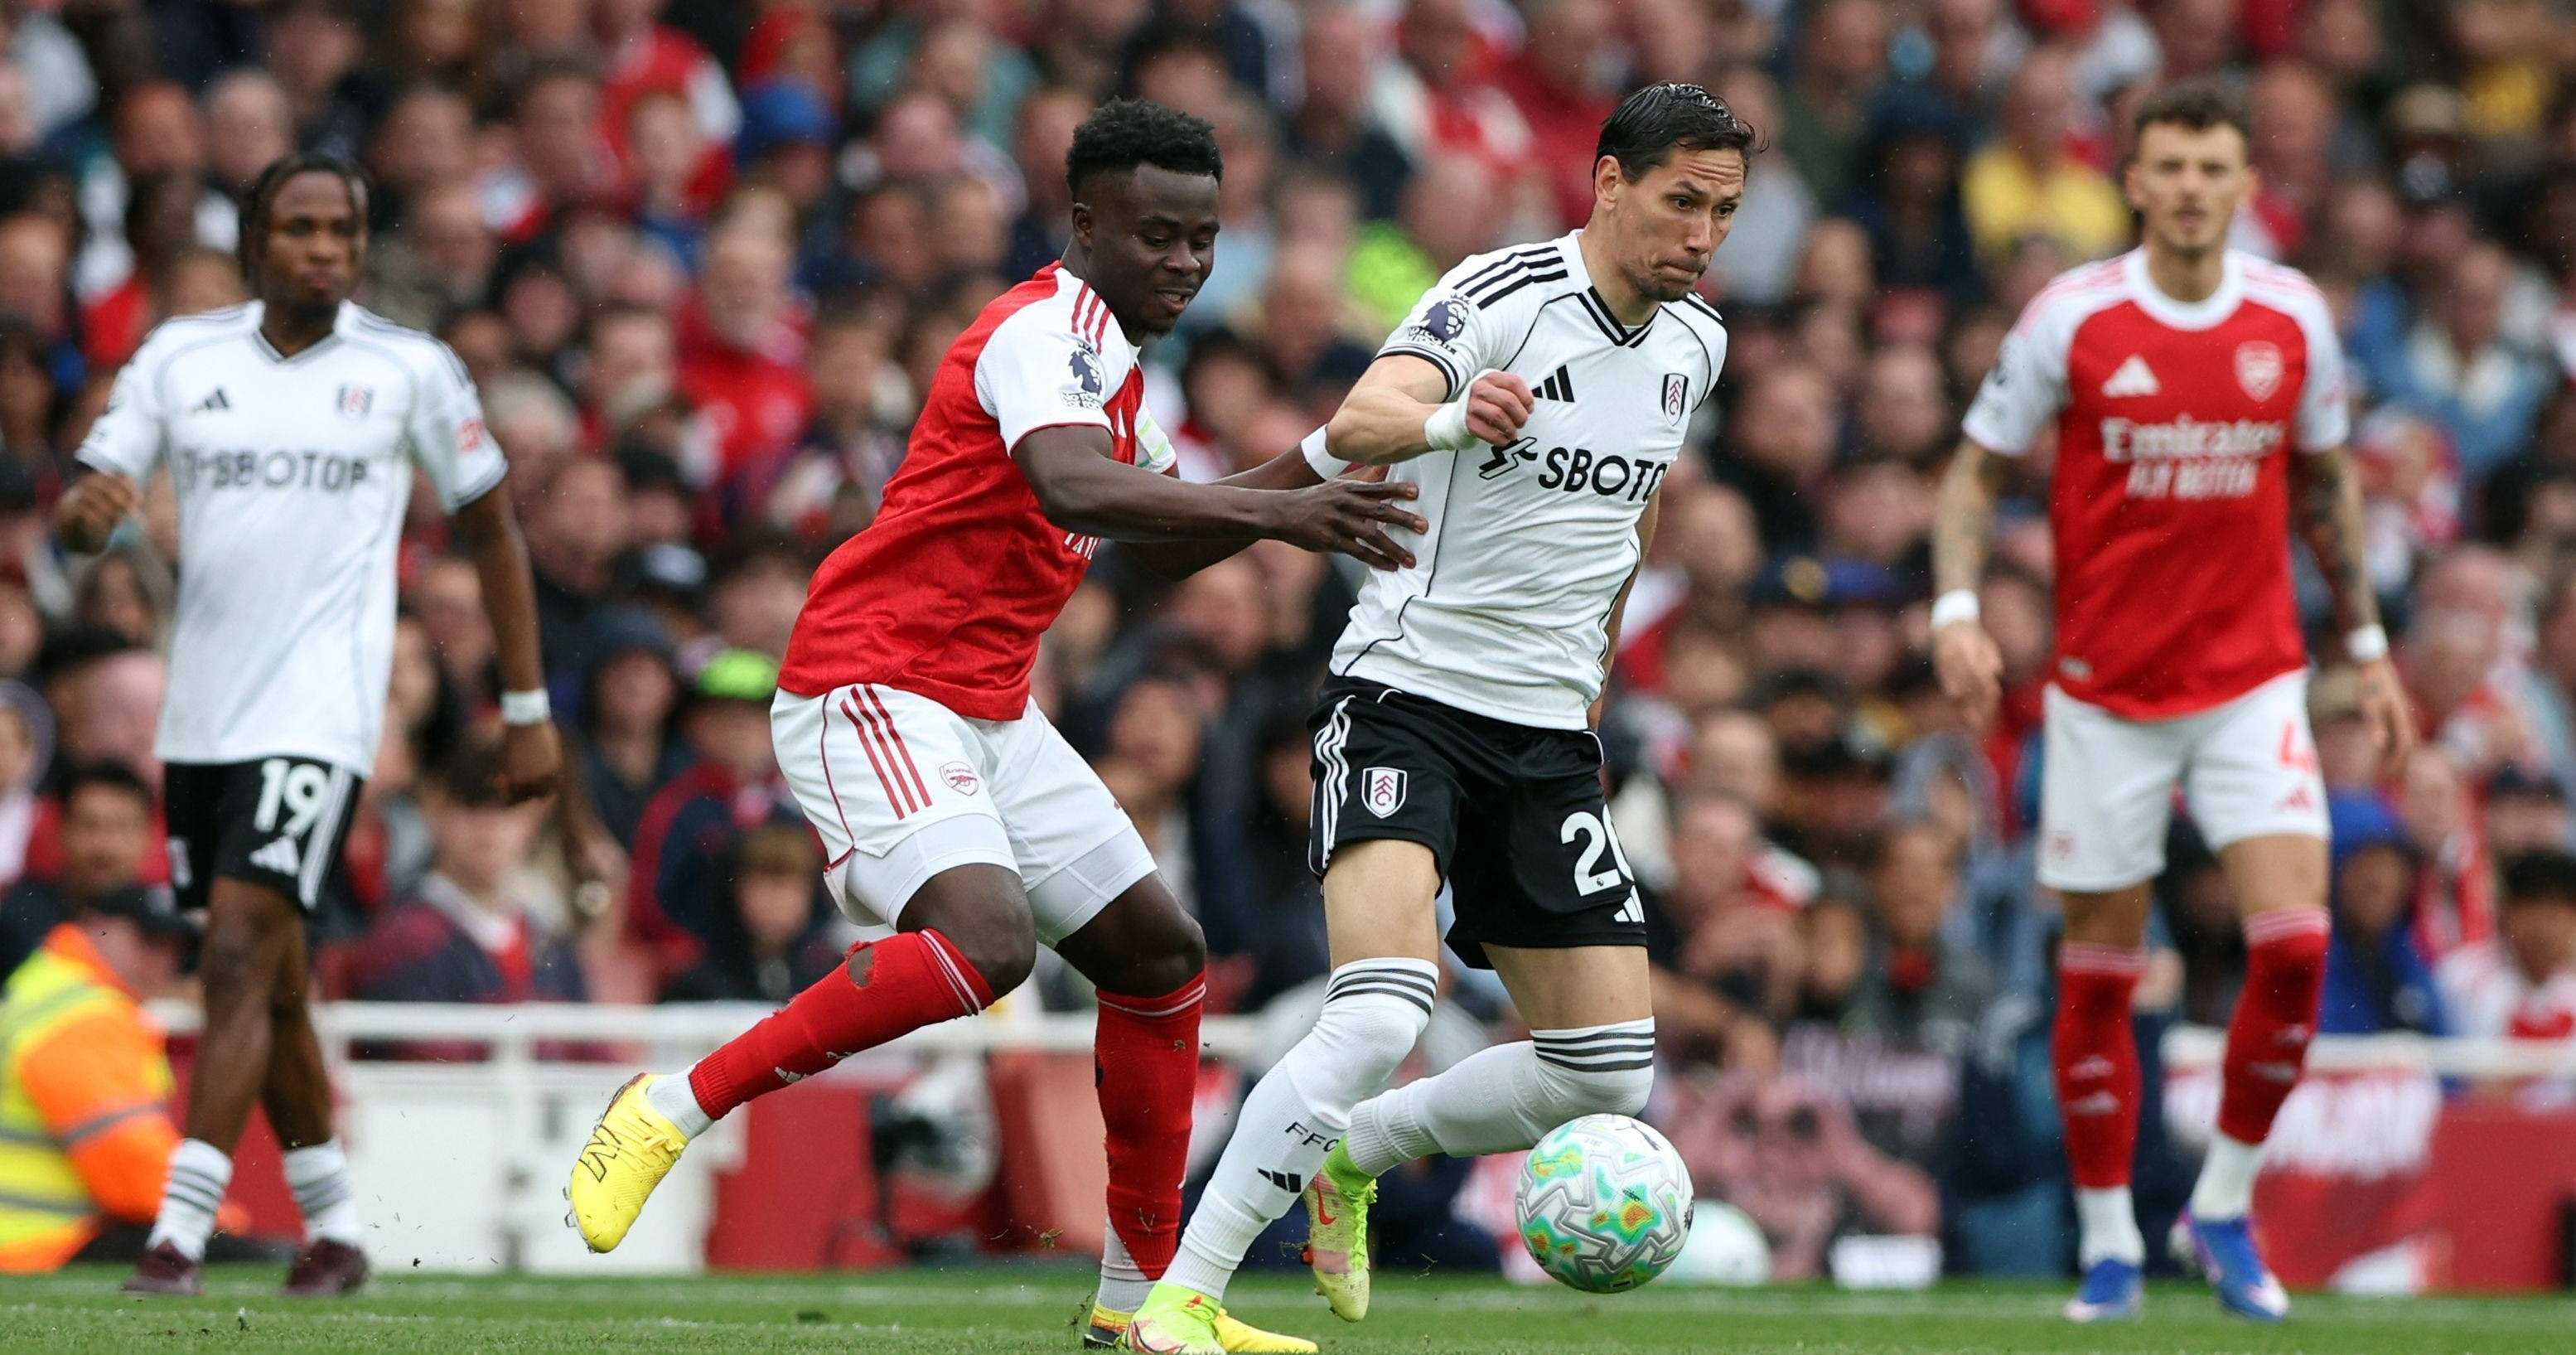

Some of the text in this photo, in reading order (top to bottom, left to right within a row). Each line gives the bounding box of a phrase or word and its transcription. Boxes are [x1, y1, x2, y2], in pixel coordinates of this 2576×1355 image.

[2100, 413, 2284, 462] Emirates
[212, 448, 367, 491] SBOTOP
[254, 757, 331, 839] 19
[1284, 1121, 1339, 1152] FFC
